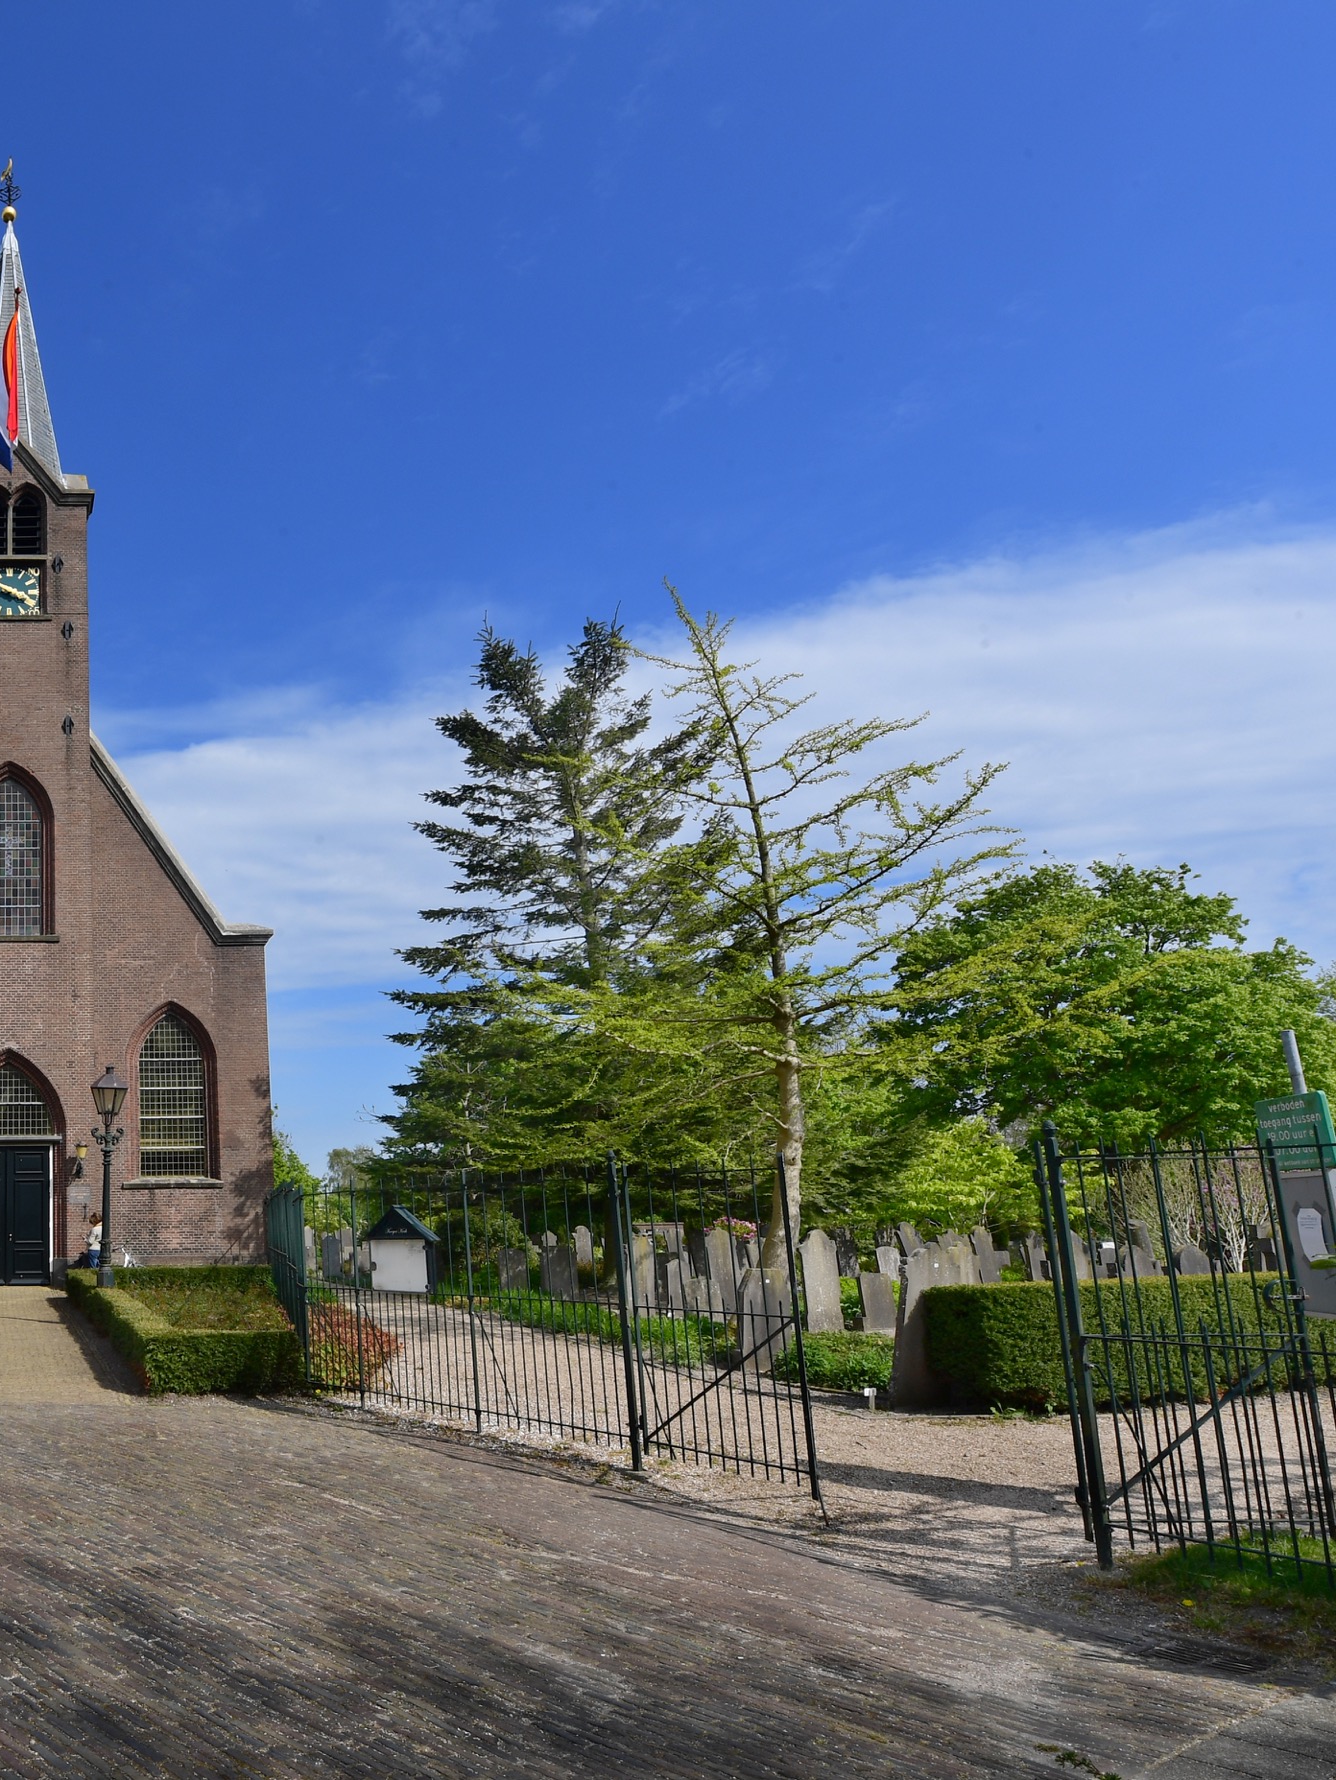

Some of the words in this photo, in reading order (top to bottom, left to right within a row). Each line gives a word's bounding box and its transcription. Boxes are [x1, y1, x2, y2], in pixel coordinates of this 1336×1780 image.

[1268, 1100, 1305, 1113] verboden
[1259, 1117, 1292, 1129] toegang
[1293, 1113, 1322, 1124] tussen
[1292, 1131, 1306, 1139] uur
